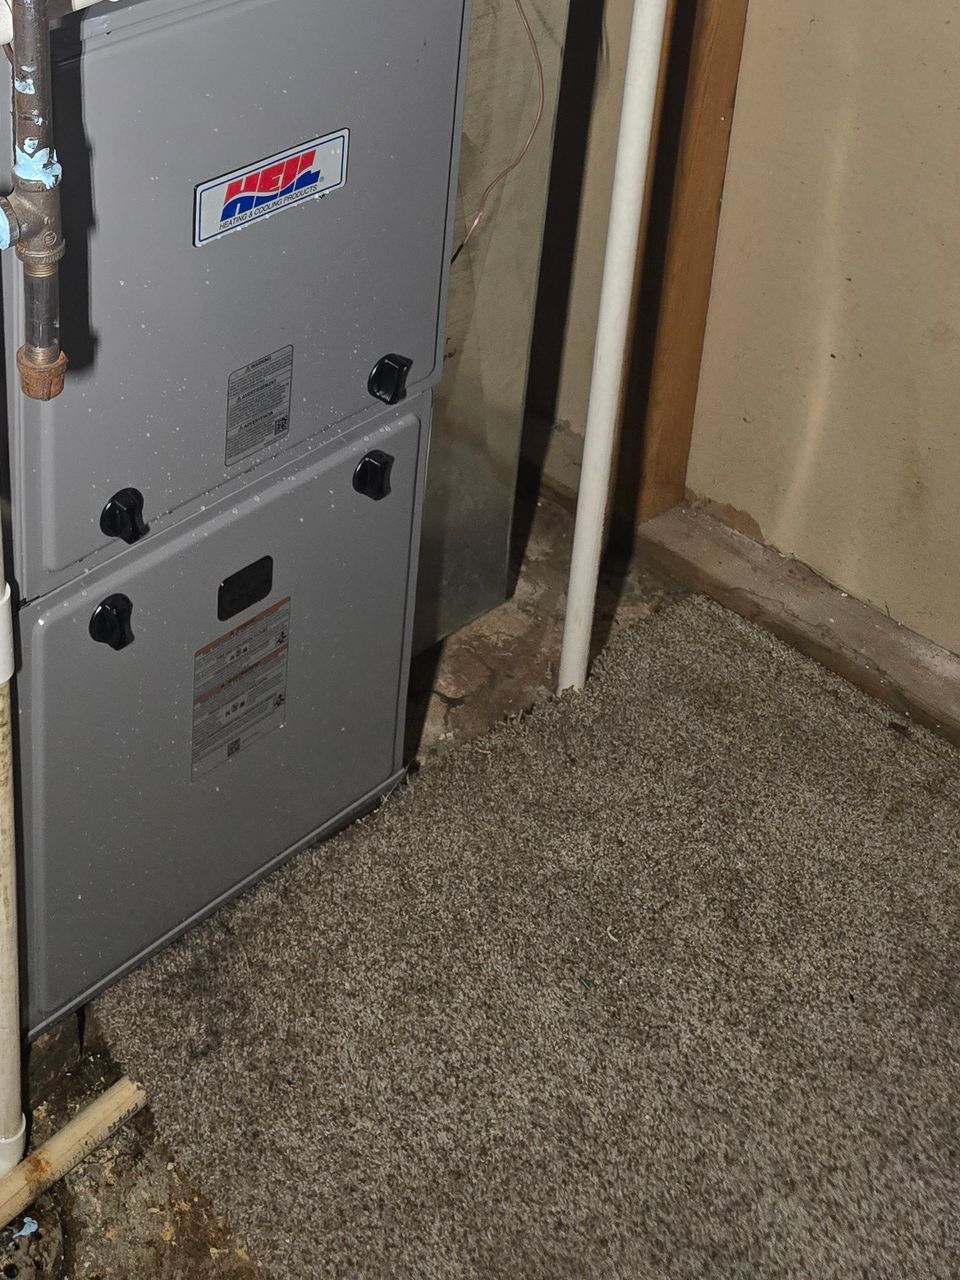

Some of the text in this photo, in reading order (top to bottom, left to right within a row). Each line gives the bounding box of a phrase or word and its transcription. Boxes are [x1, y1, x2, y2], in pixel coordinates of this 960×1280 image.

[219, 184, 318, 230] HEATING & COOLING PRODUCTS
